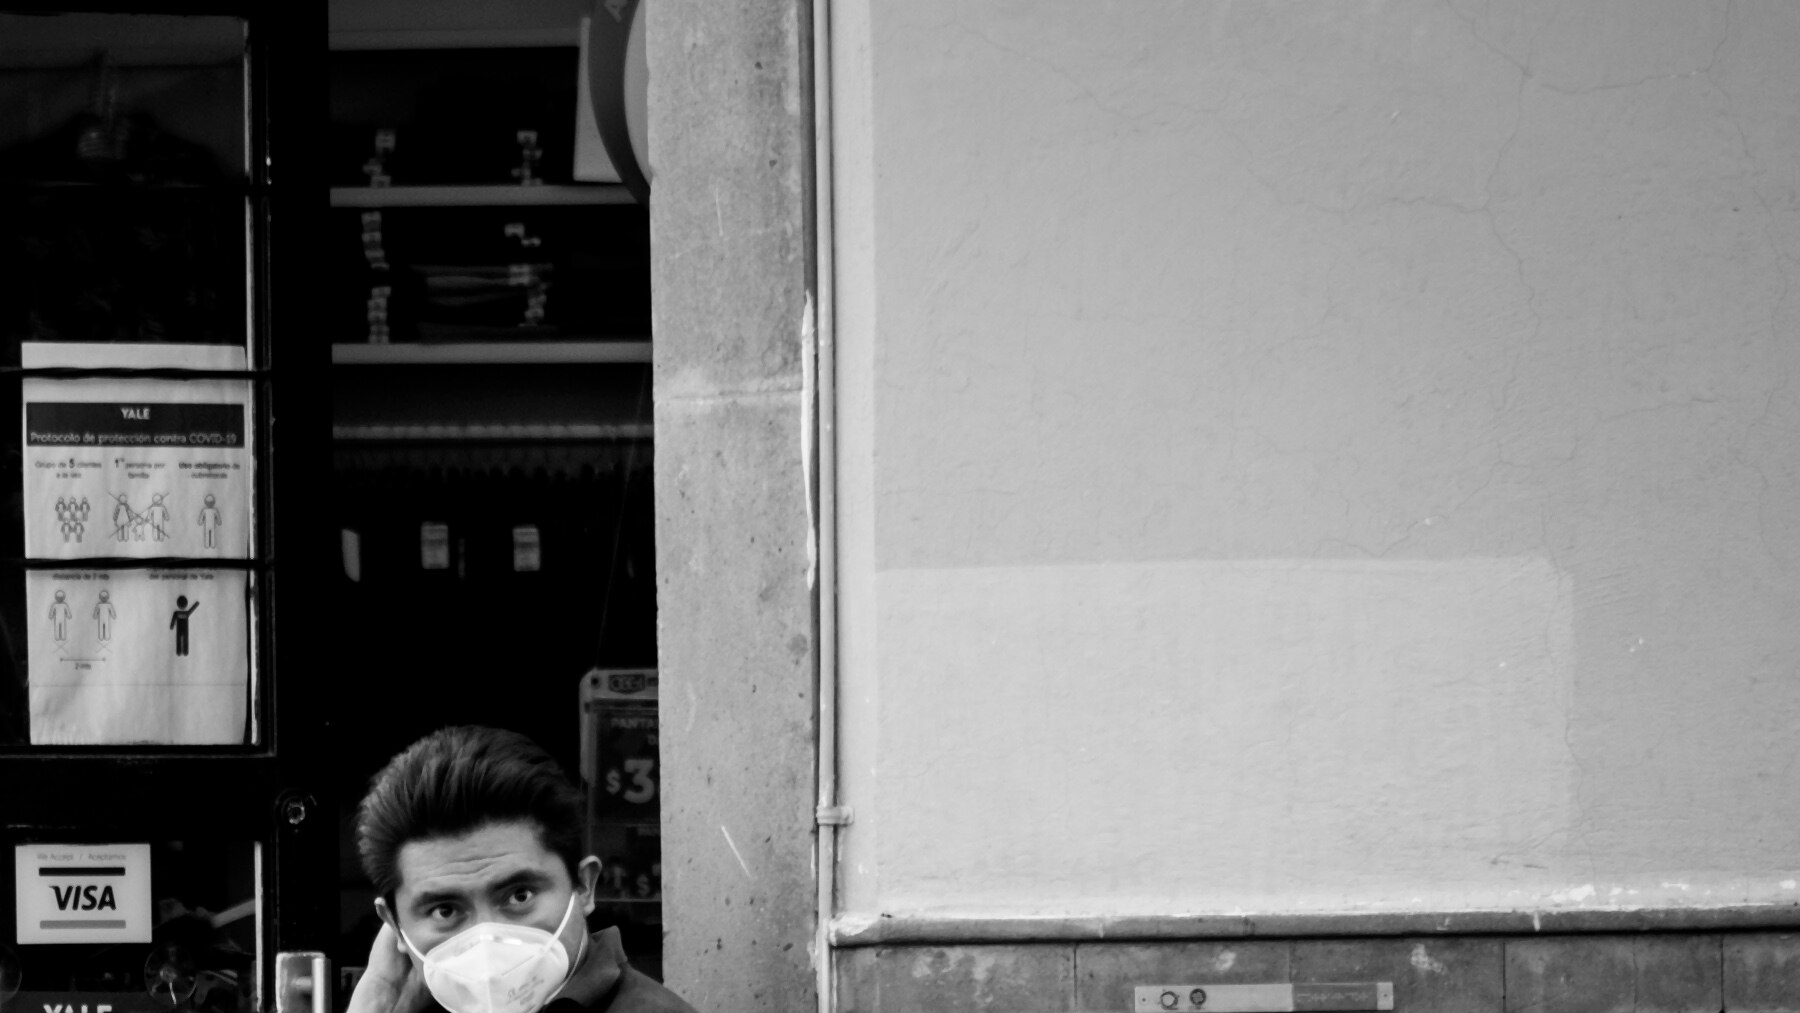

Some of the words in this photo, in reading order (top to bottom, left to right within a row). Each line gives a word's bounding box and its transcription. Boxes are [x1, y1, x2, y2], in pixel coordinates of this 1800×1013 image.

[121, 407, 150, 420] YALE
[30, 432, 80, 443] Protocolo
[83, 432, 96, 443] de
[154, 433, 186, 443] contra
[189, 433, 237, 444] COVID-19
[611, 717, 657, 729] PANTA
[605, 758, 657, 804] $3
[49, 885, 116, 911] VISA
